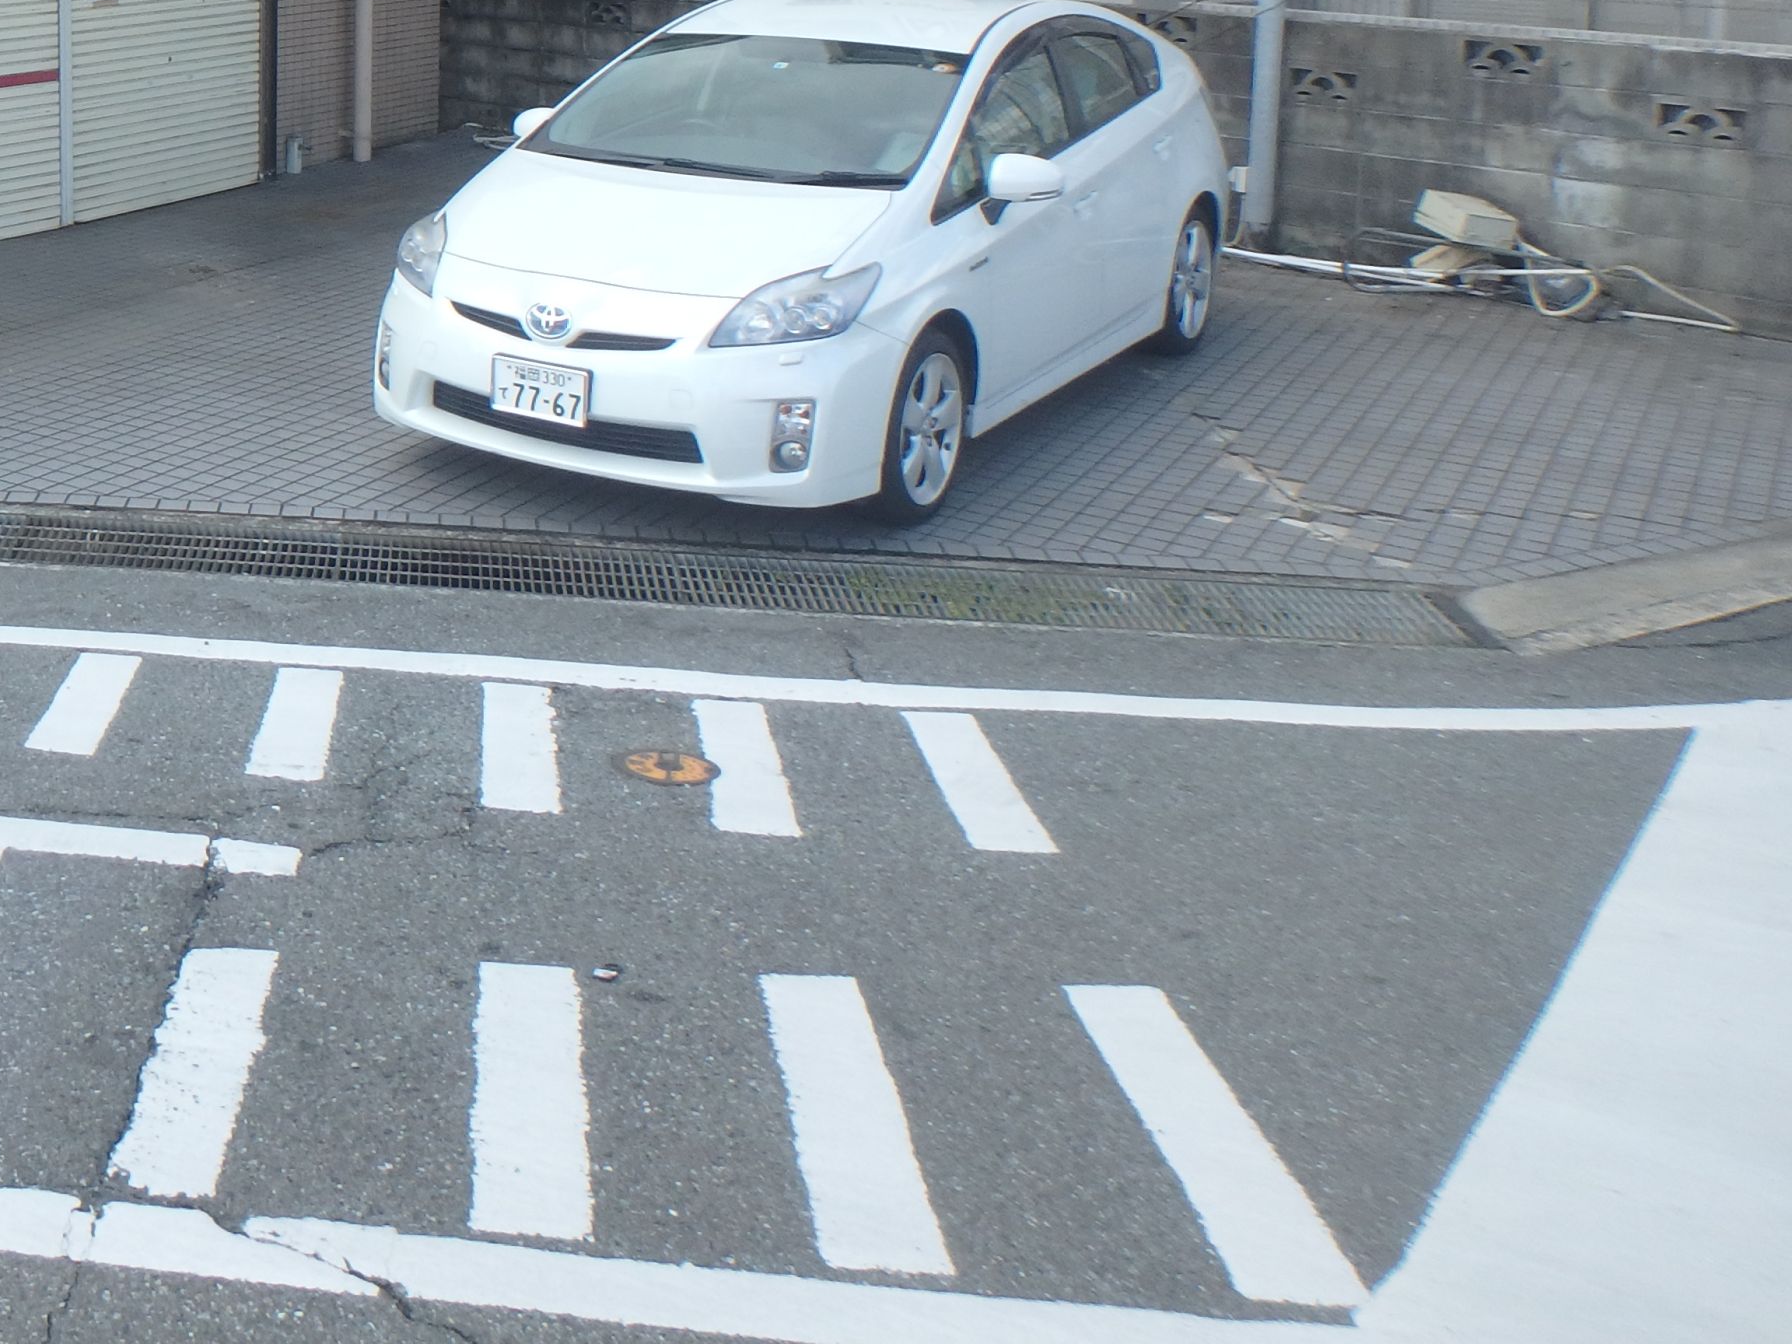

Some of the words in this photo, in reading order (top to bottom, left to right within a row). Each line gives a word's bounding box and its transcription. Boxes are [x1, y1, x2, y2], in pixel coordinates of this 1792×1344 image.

[514, 365, 540, 382] 福岡
[542, 370, 566, 387] 330
[498, 387, 509, 399] て
[513, 382, 582, 420] 77-67
